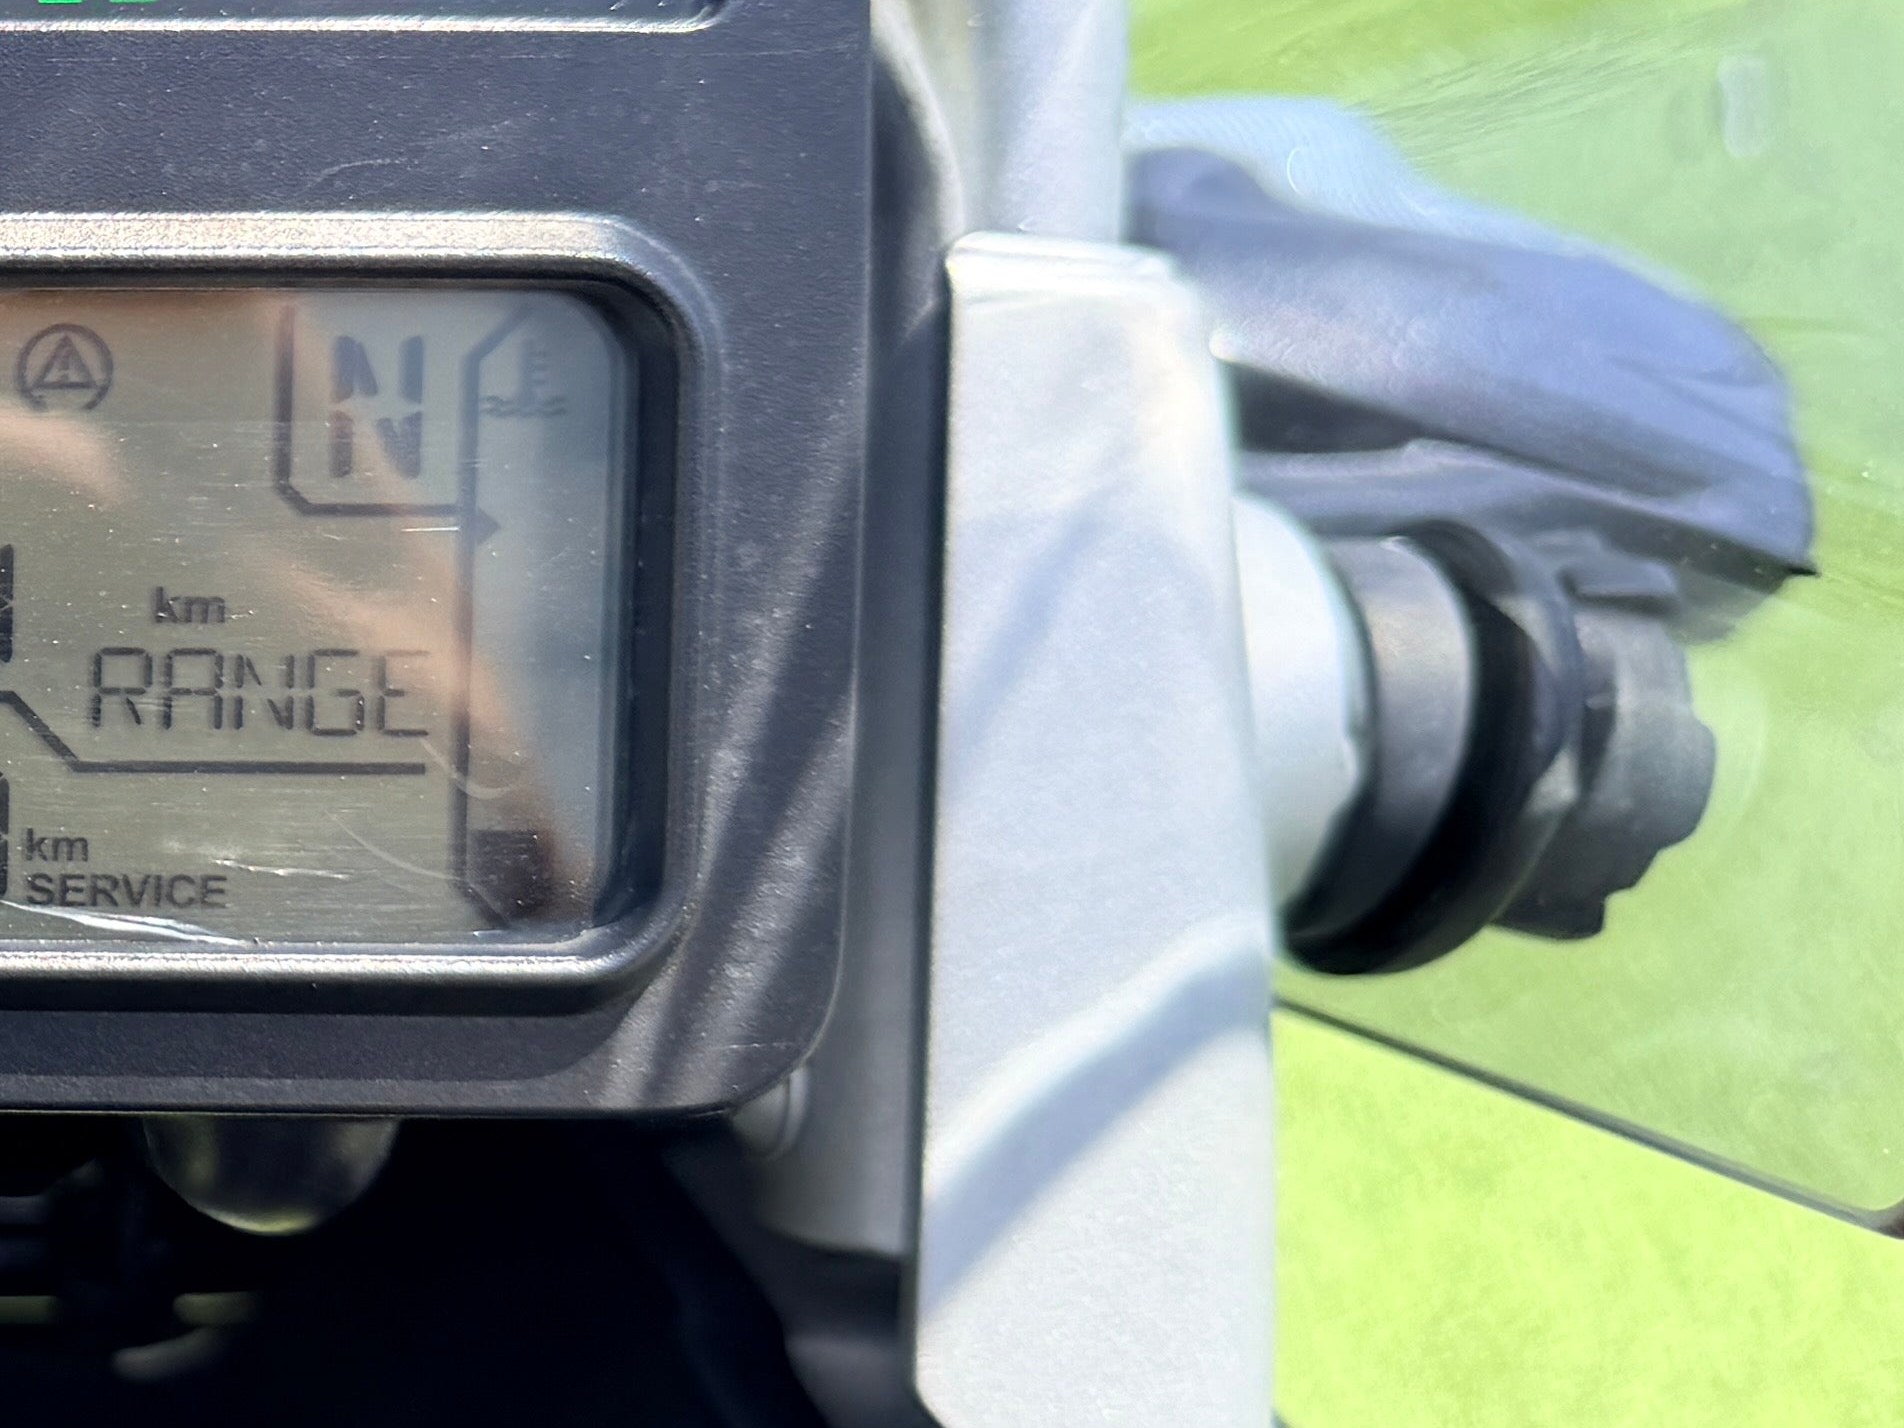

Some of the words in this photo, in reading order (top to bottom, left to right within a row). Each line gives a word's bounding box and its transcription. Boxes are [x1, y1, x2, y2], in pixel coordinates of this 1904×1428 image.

[330, 335, 425, 480] N
[151, 587, 226, 623] km
[93, 647, 429, 736] RANGE
[26, 828, 88, 861] km
[27, 874, 228, 908] SERVICE
